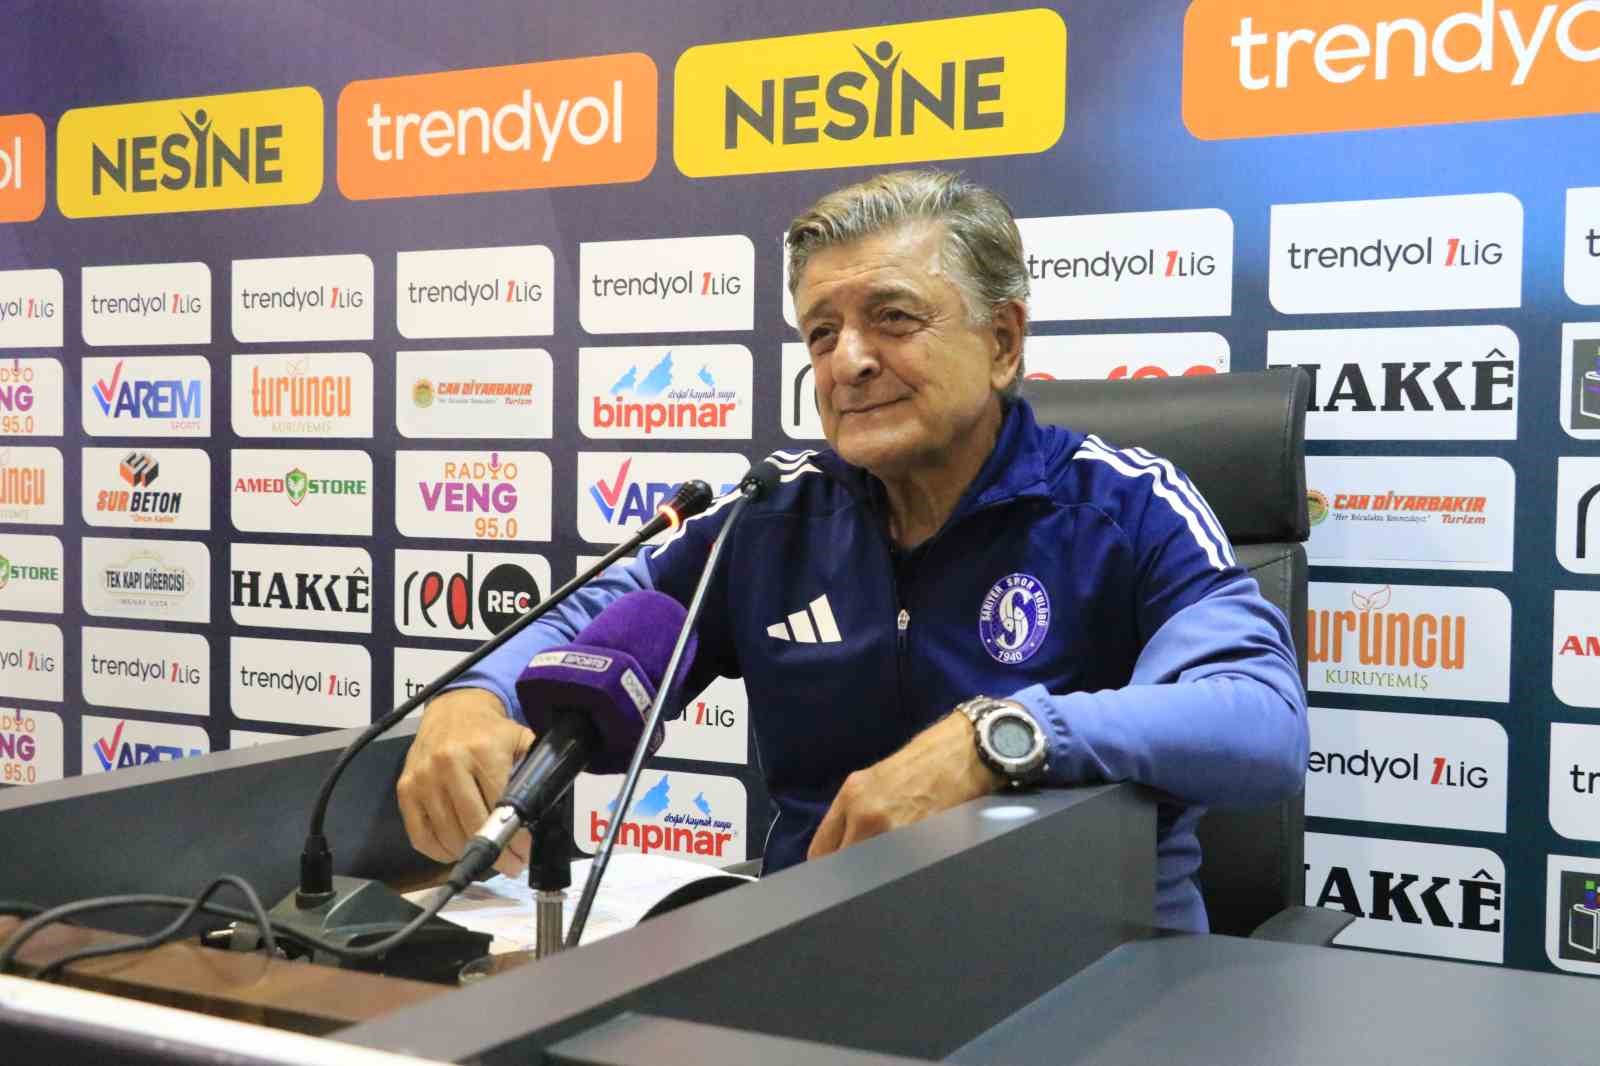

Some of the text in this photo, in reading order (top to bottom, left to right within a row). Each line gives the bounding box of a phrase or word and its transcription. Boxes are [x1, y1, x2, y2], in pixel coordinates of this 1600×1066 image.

[367, 80, 623, 162] trendyol
[1027, 249, 1154, 282] trendyol
[1288, 236, 1432, 272] trendyol
[408, 279, 499, 306] trendyol
[592, 270, 693, 299] trendyol
[91, 292, 167, 316] trendyol
[241, 286, 324, 314] trendyol
[91, 359, 201, 419] VAREM
[234, 477, 367, 495] AMED STORE
[419, 481, 518, 514] VENG
[130, 491, 182, 514] BETON
[1333, 493, 1370, 511] CAN
[473, 516, 518, 539] 95.0
[1440, 515, 1486, 525] Turizm
[11, 565, 59, 581] STORE
[105, 570, 122, 589] TEK
[123, 571, 143, 591] KAPI
[403, 553, 532, 629] red REC
[1306, 606, 1466, 671] uruncu
[91, 654, 166, 683] trendyol
[998, 650, 1024, 662] 1940
[240, 664, 323, 695] trendyol
[4, 762, 36, 784] 95.0
[1306, 749, 1419, 784] endyol
[1304, 864, 1501, 933] AKKÊ
